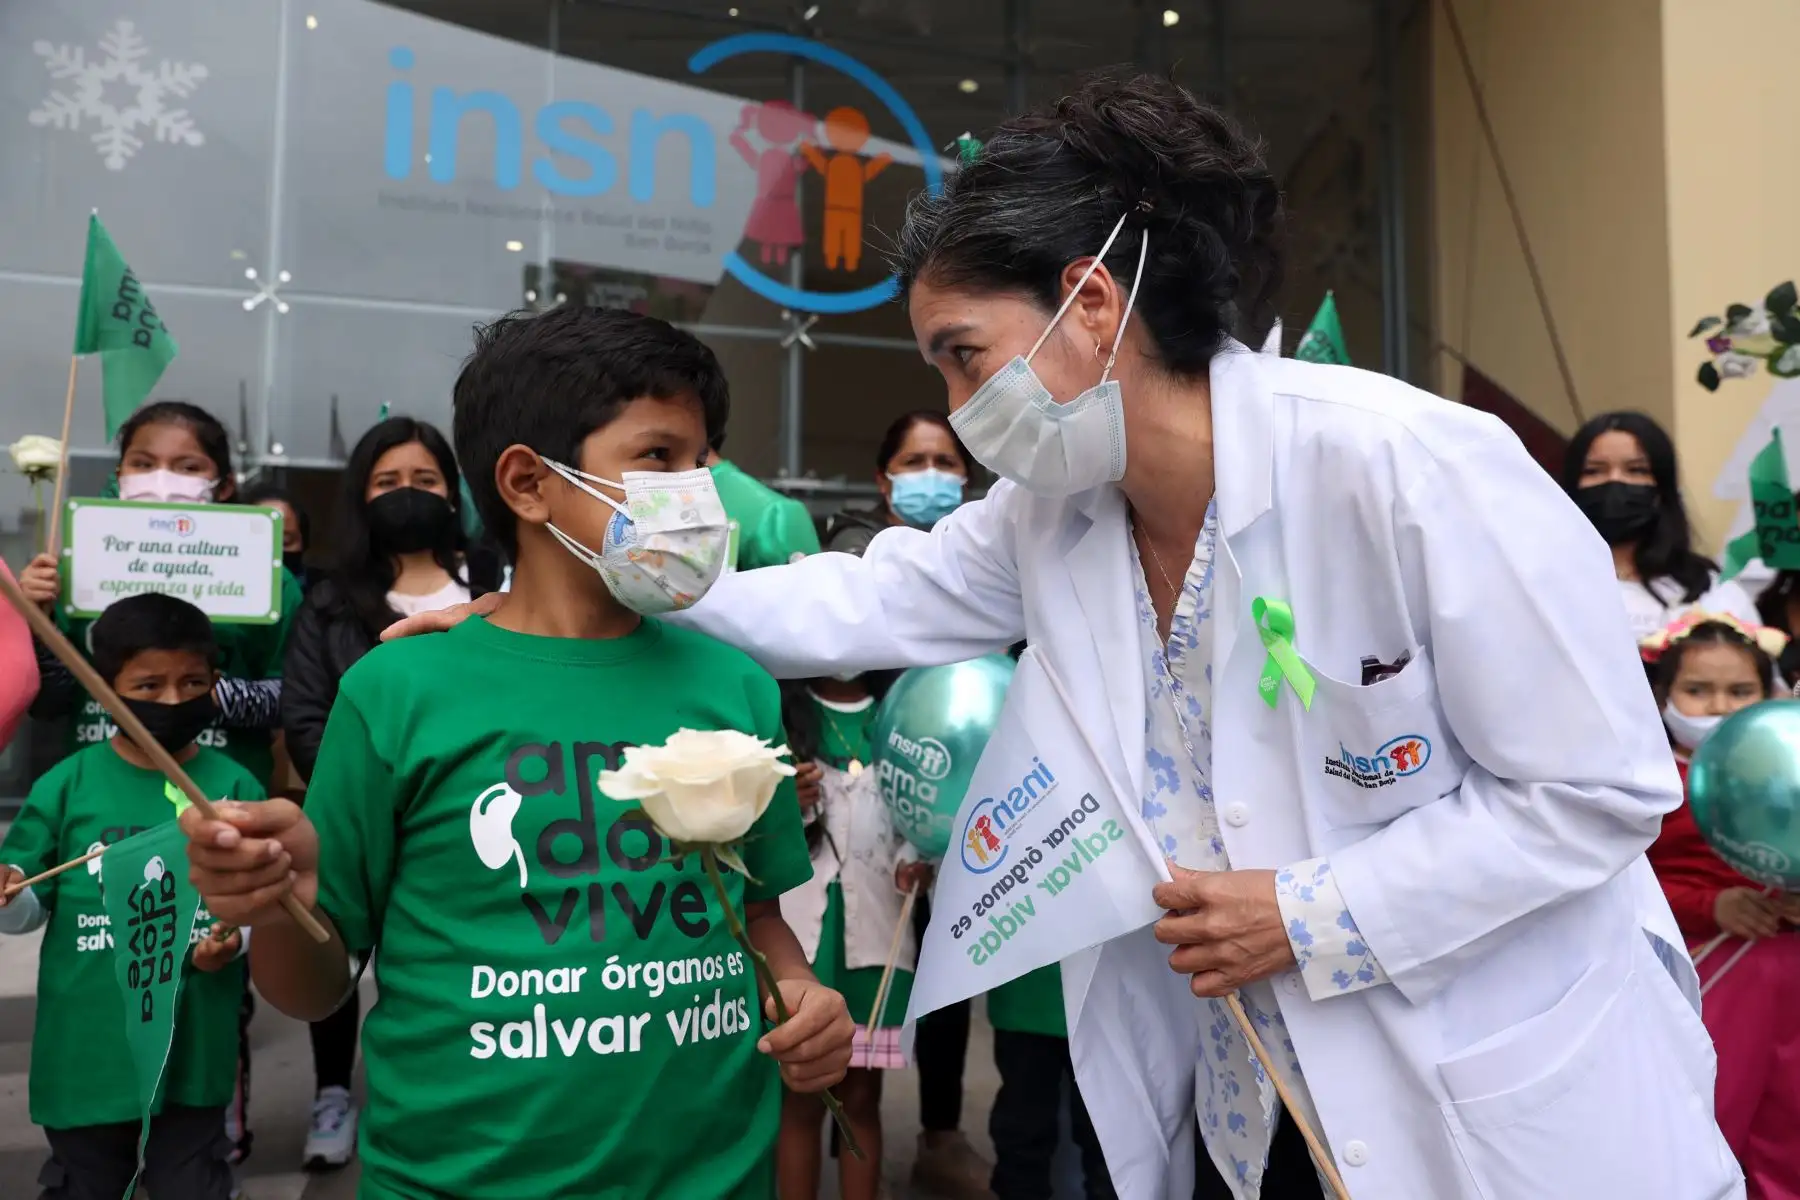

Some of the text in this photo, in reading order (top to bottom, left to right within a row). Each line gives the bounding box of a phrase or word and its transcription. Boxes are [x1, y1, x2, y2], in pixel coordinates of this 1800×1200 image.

[384, 46, 717, 208] insn
[102, 534, 239, 557] Por una cultura
[128, 558, 214, 579] de ayuda,
[207, 580, 245, 597] vida
[888, 727, 923, 759] insn
[879, 758, 939, 804] ama
[1325, 766, 1342, 777] Salud
[127, 883, 142, 989] vive
[159, 870, 177, 984] ama
[521, 880, 711, 946] vive
[141, 889, 164, 1024] dona
[471, 950, 745, 998] Donar órganos es
[469, 988, 751, 1060] salvar vidas
